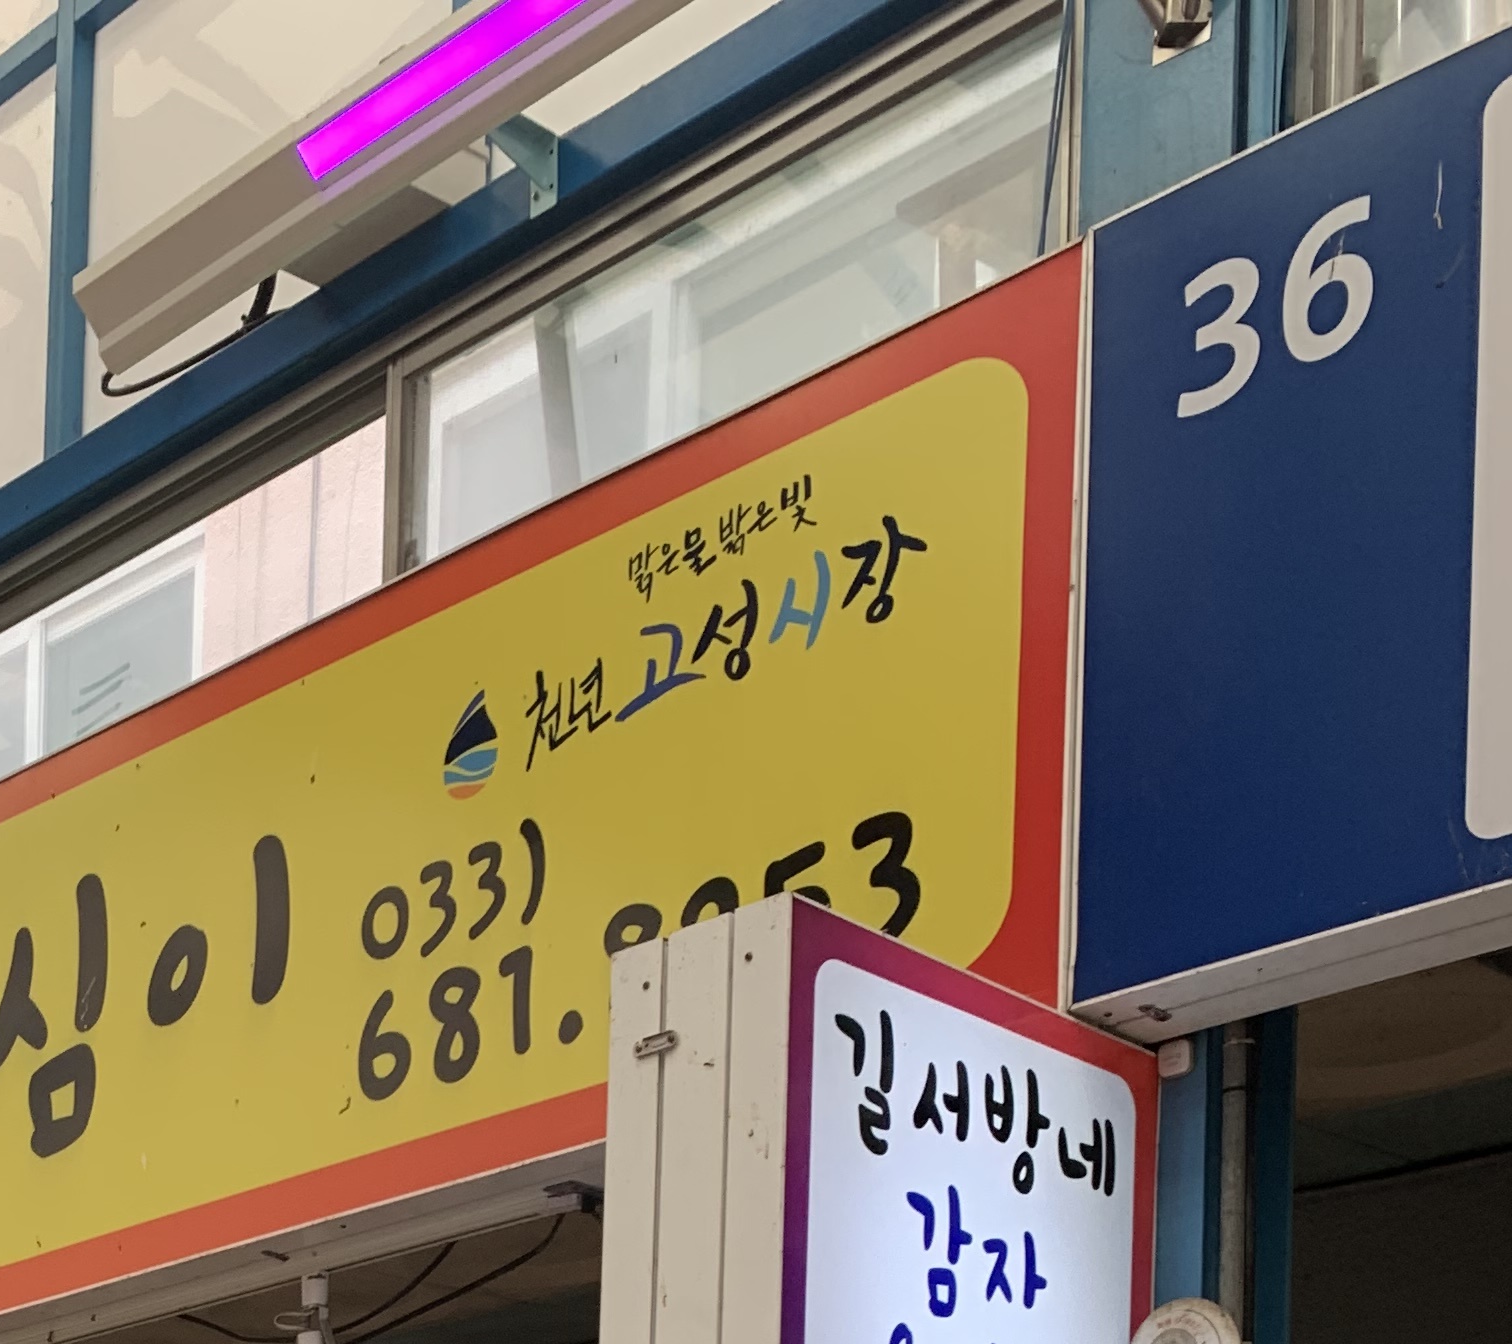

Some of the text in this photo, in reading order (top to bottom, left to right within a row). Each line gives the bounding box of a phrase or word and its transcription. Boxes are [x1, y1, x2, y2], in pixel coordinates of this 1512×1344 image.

[1176, 195, 1375, 418] 36
[615, 515, 928, 723] 고성시장
[361, 817, 547, 961] 033)
[833, 1010, 1117, 1197] 길서방네
[906, 1184, 1048, 1319] 감자
